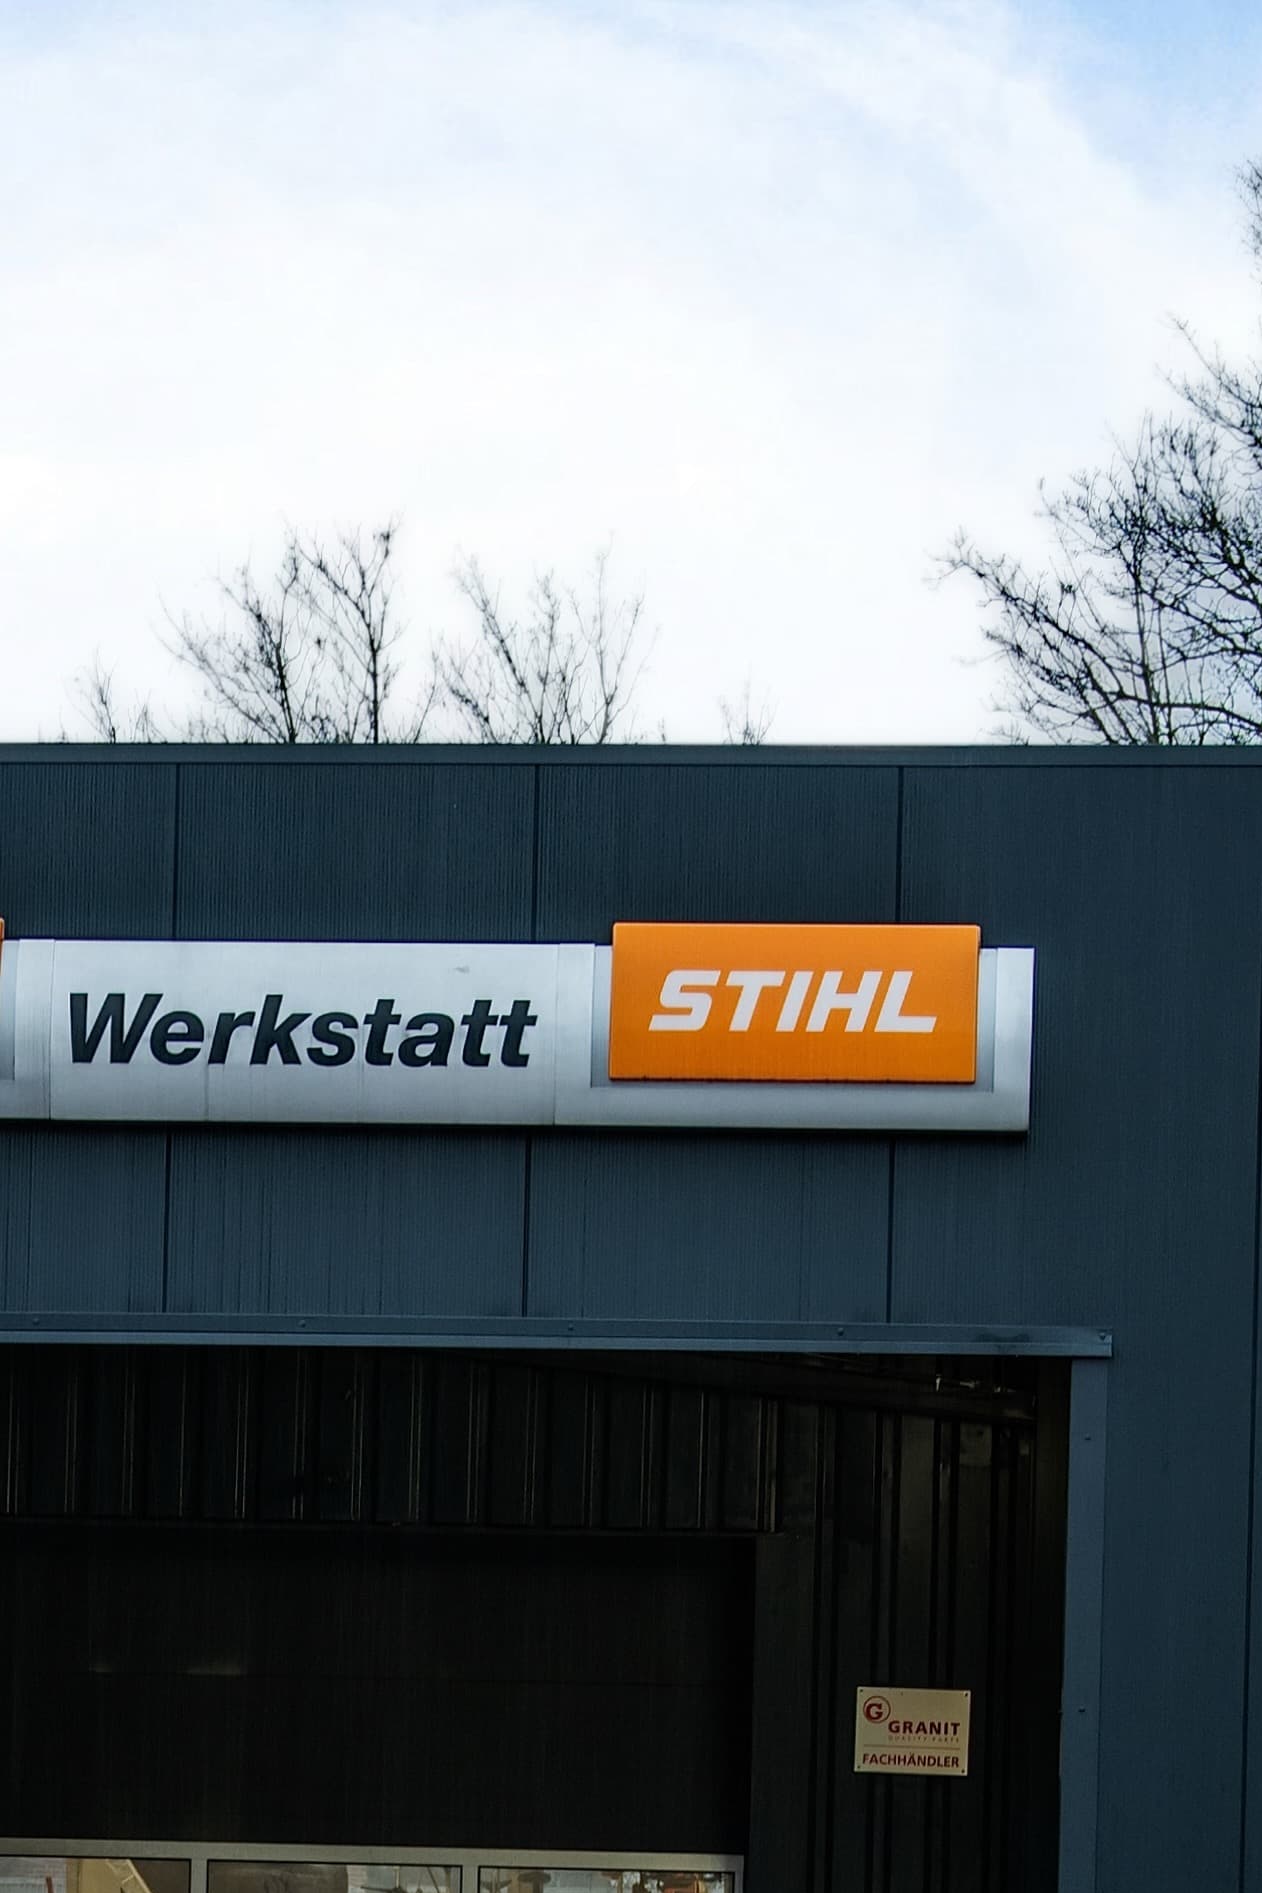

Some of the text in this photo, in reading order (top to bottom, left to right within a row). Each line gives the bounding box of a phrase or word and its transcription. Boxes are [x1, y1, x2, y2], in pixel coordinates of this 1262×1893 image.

[647, 968, 938, 1034] STIHL
[67, 990, 539, 1068] Werkstatt
[887, 1720, 961, 1736] GRANIT
[862, 1751, 960, 1769] FACHHÄNDLER
